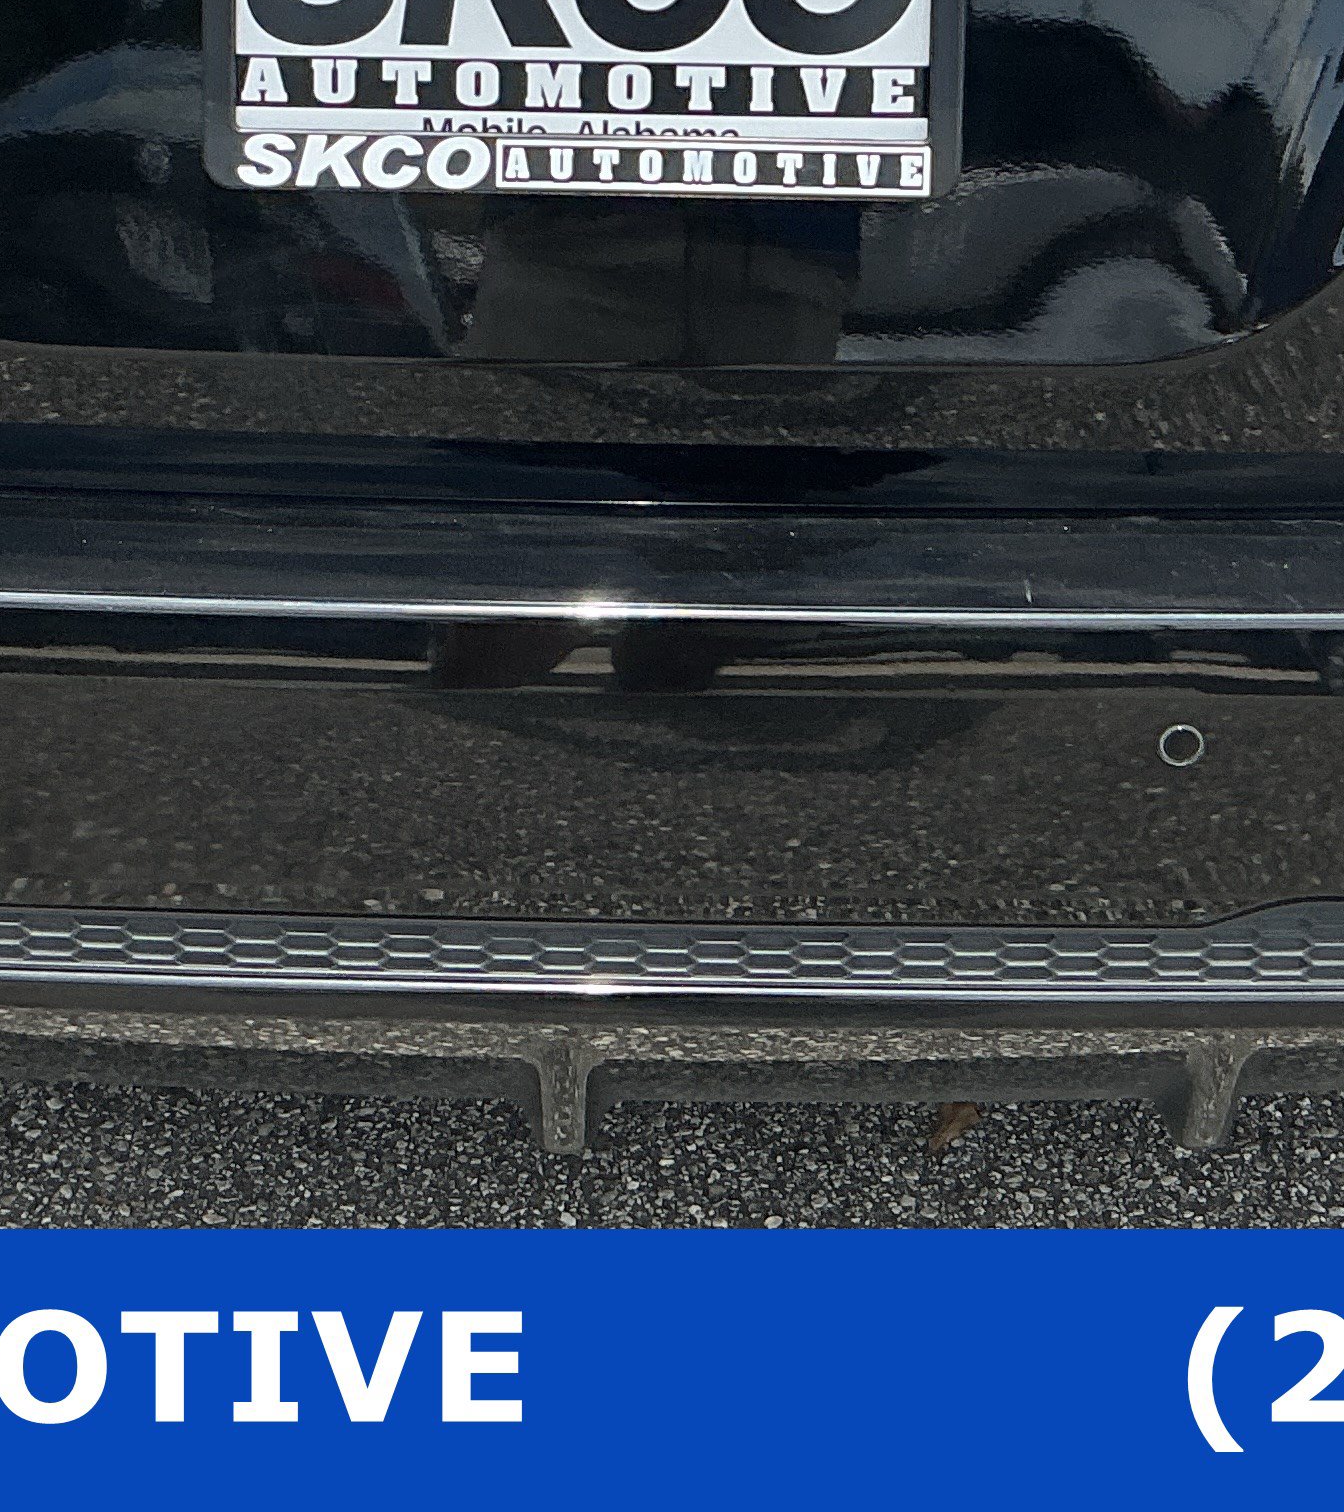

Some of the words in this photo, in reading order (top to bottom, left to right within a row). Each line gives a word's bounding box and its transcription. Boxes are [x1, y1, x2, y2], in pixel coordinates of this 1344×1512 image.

[240, 56, 916, 114] AUTOMOTIVE
[237, 133, 492, 190] SKCO
[504, 147, 924, 187] AUTOMOTIVE
